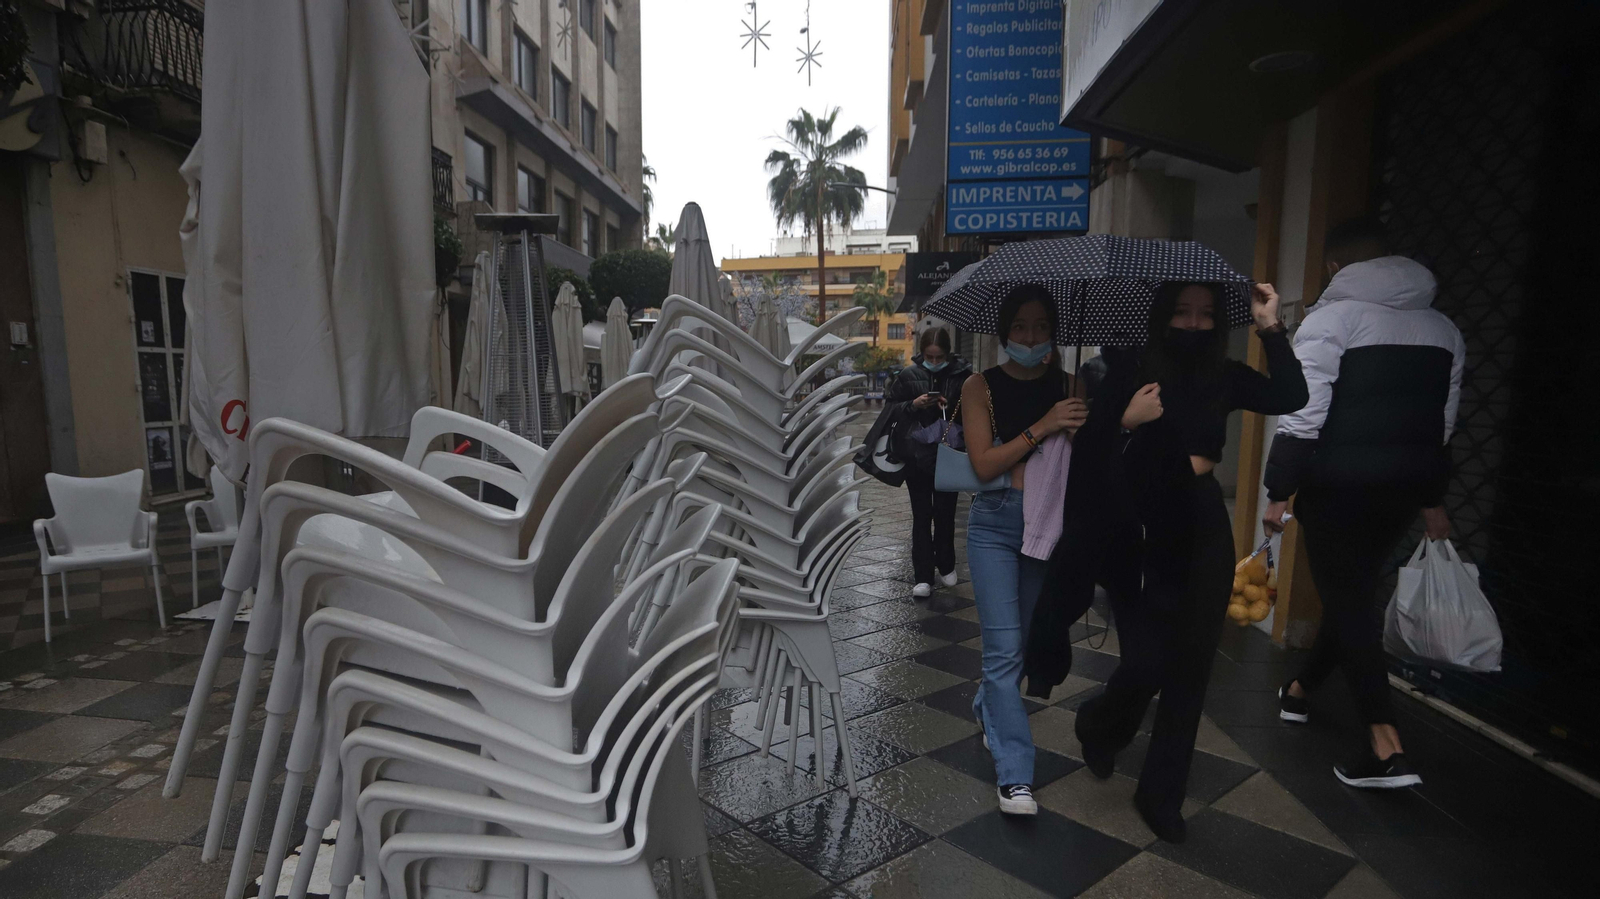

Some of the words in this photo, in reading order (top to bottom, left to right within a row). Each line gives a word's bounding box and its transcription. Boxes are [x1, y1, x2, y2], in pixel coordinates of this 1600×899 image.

[966, 1, 1015, 16] Imprenta
[966, 21, 1008, 37] Regalos
[966, 45, 1005, 58] Ofertas
[965, 68, 1020, 82] Camisetas
[1031, 66, 1062, 79] Tazas
[965, 93, 1018, 107] Cartelería
[1028, 93, 1062, 105] Plano
[965, 121, 996, 134] Sellos
[999, 120, 1012, 133] de
[1015, 119, 1055, 132] Caucho
[969, 149, 986, 160] Tlf:
[992, 149, 1014, 160] 956
[1017, 148, 1032, 159] 65
[1035, 147, 1051, 158] 36
[1053, 147, 1069, 158] 69
[960, 161, 1077, 176] www.gibralcop.es
[952, 185, 1057, 204] IMPRENTA
[954, 211, 1082, 230] COPISTERIA
